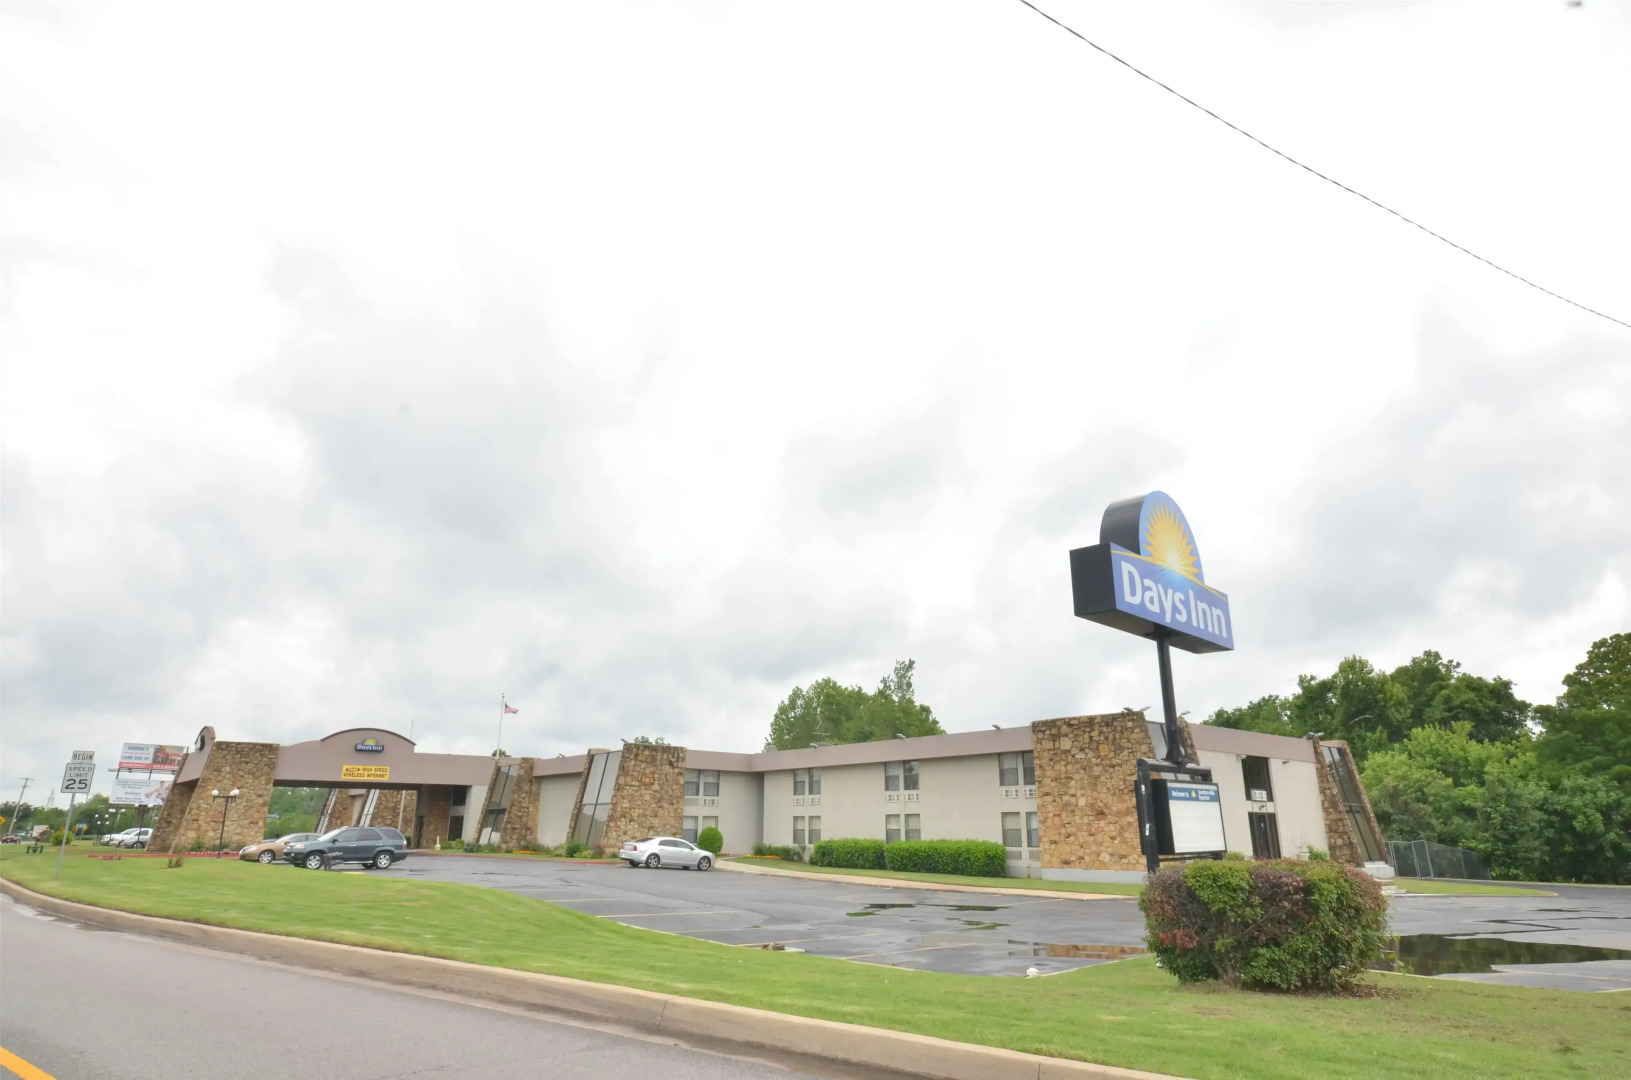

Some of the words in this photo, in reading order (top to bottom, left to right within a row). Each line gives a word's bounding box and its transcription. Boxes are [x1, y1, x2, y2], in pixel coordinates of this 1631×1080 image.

[1121, 561, 1188, 623] Days
[1188, 589, 1228, 638] Inn
[72, 753, 93, 761] BEGIN
[65, 778, 88, 790] 25
